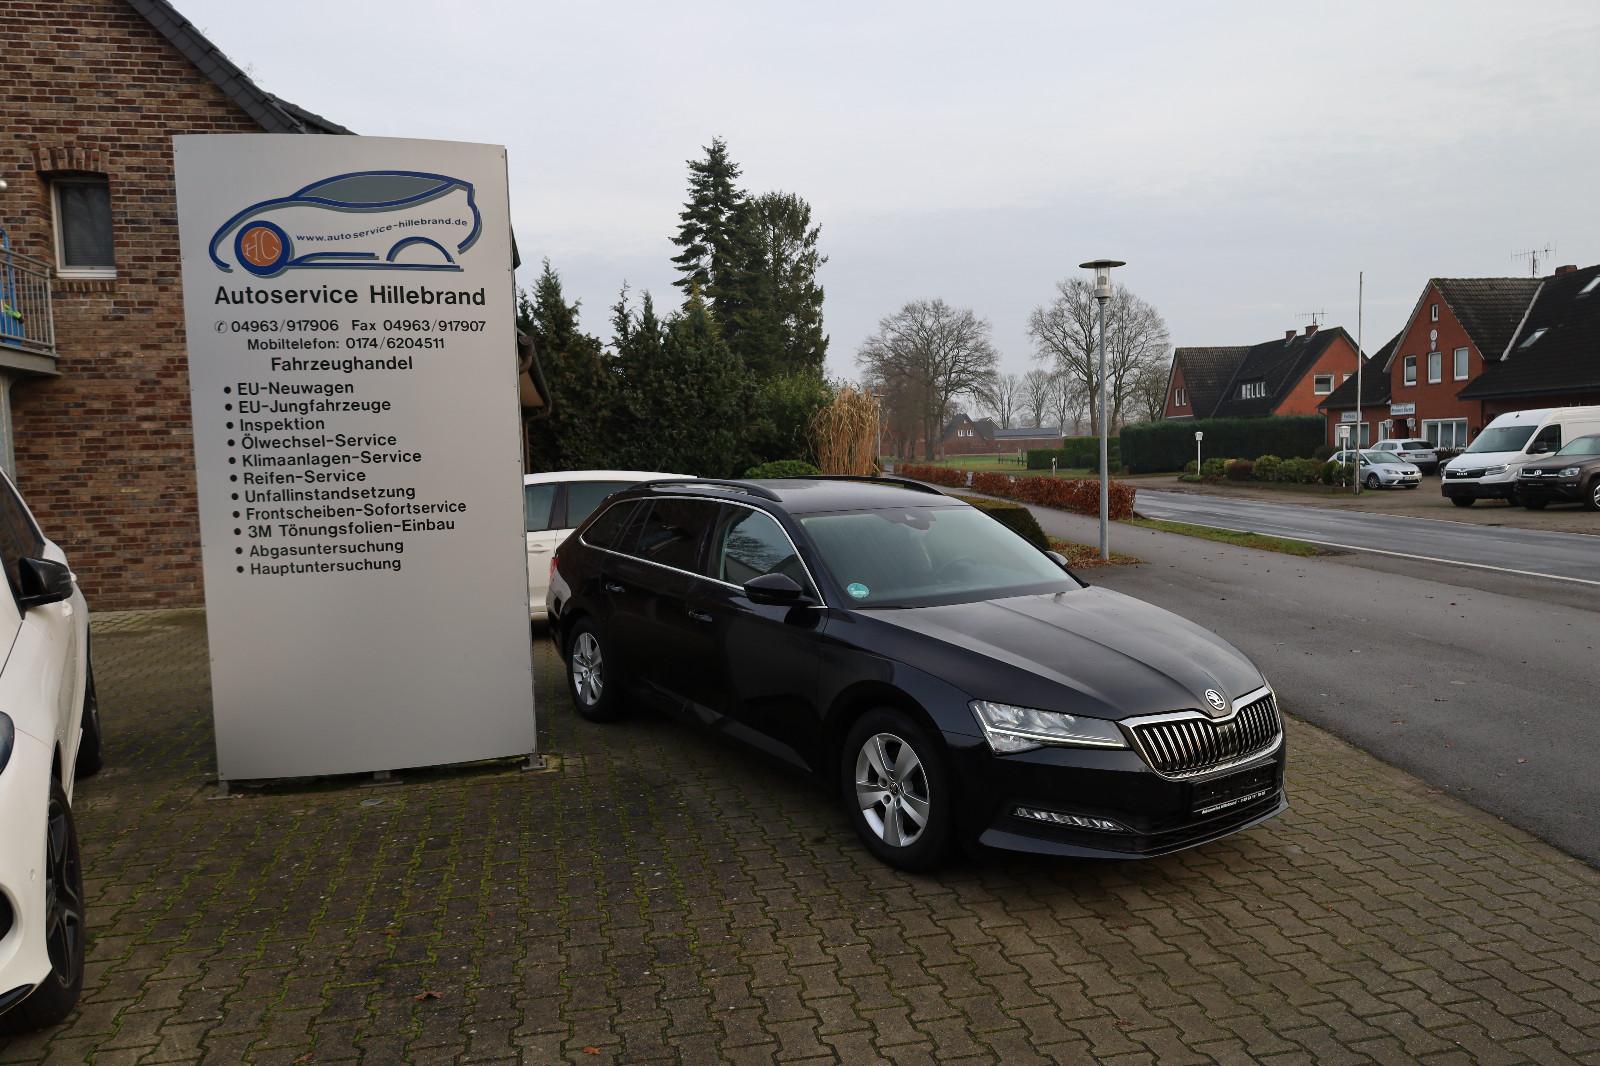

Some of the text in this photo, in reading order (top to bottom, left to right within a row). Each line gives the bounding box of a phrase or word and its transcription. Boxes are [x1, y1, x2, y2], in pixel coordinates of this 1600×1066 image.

[296, 217, 468, 242] www.autoservice-hillebrand.de
[214, 284, 486, 306] Autoservice Hillebrand
[230, 319, 487, 333] 04963/917906 Fax 04963/917907
[247, 336, 445, 351] Mobiltelefon: 0174/6204511
[270, 355, 413, 373] Fahrzeughandel
[237, 382, 354, 396] EU-Neuwagen
[238, 398, 392, 415] EU-Jungfahrzeuge
[239, 418, 325, 433] Inspektion
[241, 433, 398, 449] Ölwechsel-Service
[242, 450, 422, 468] Klimaanlagen-Service
[243, 469, 367, 485] Reifen-Service
[245, 485, 416, 503] Unfallinstandsetzung
[246, 500, 467, 521] Frontscheiben-Sofortservice
[248, 519, 456, 539] 3M Tönungsfolien-Einbau
[249, 540, 404, 559] Abgasuntersuchung
[250, 558, 402, 577] Hauptuntersuchung
